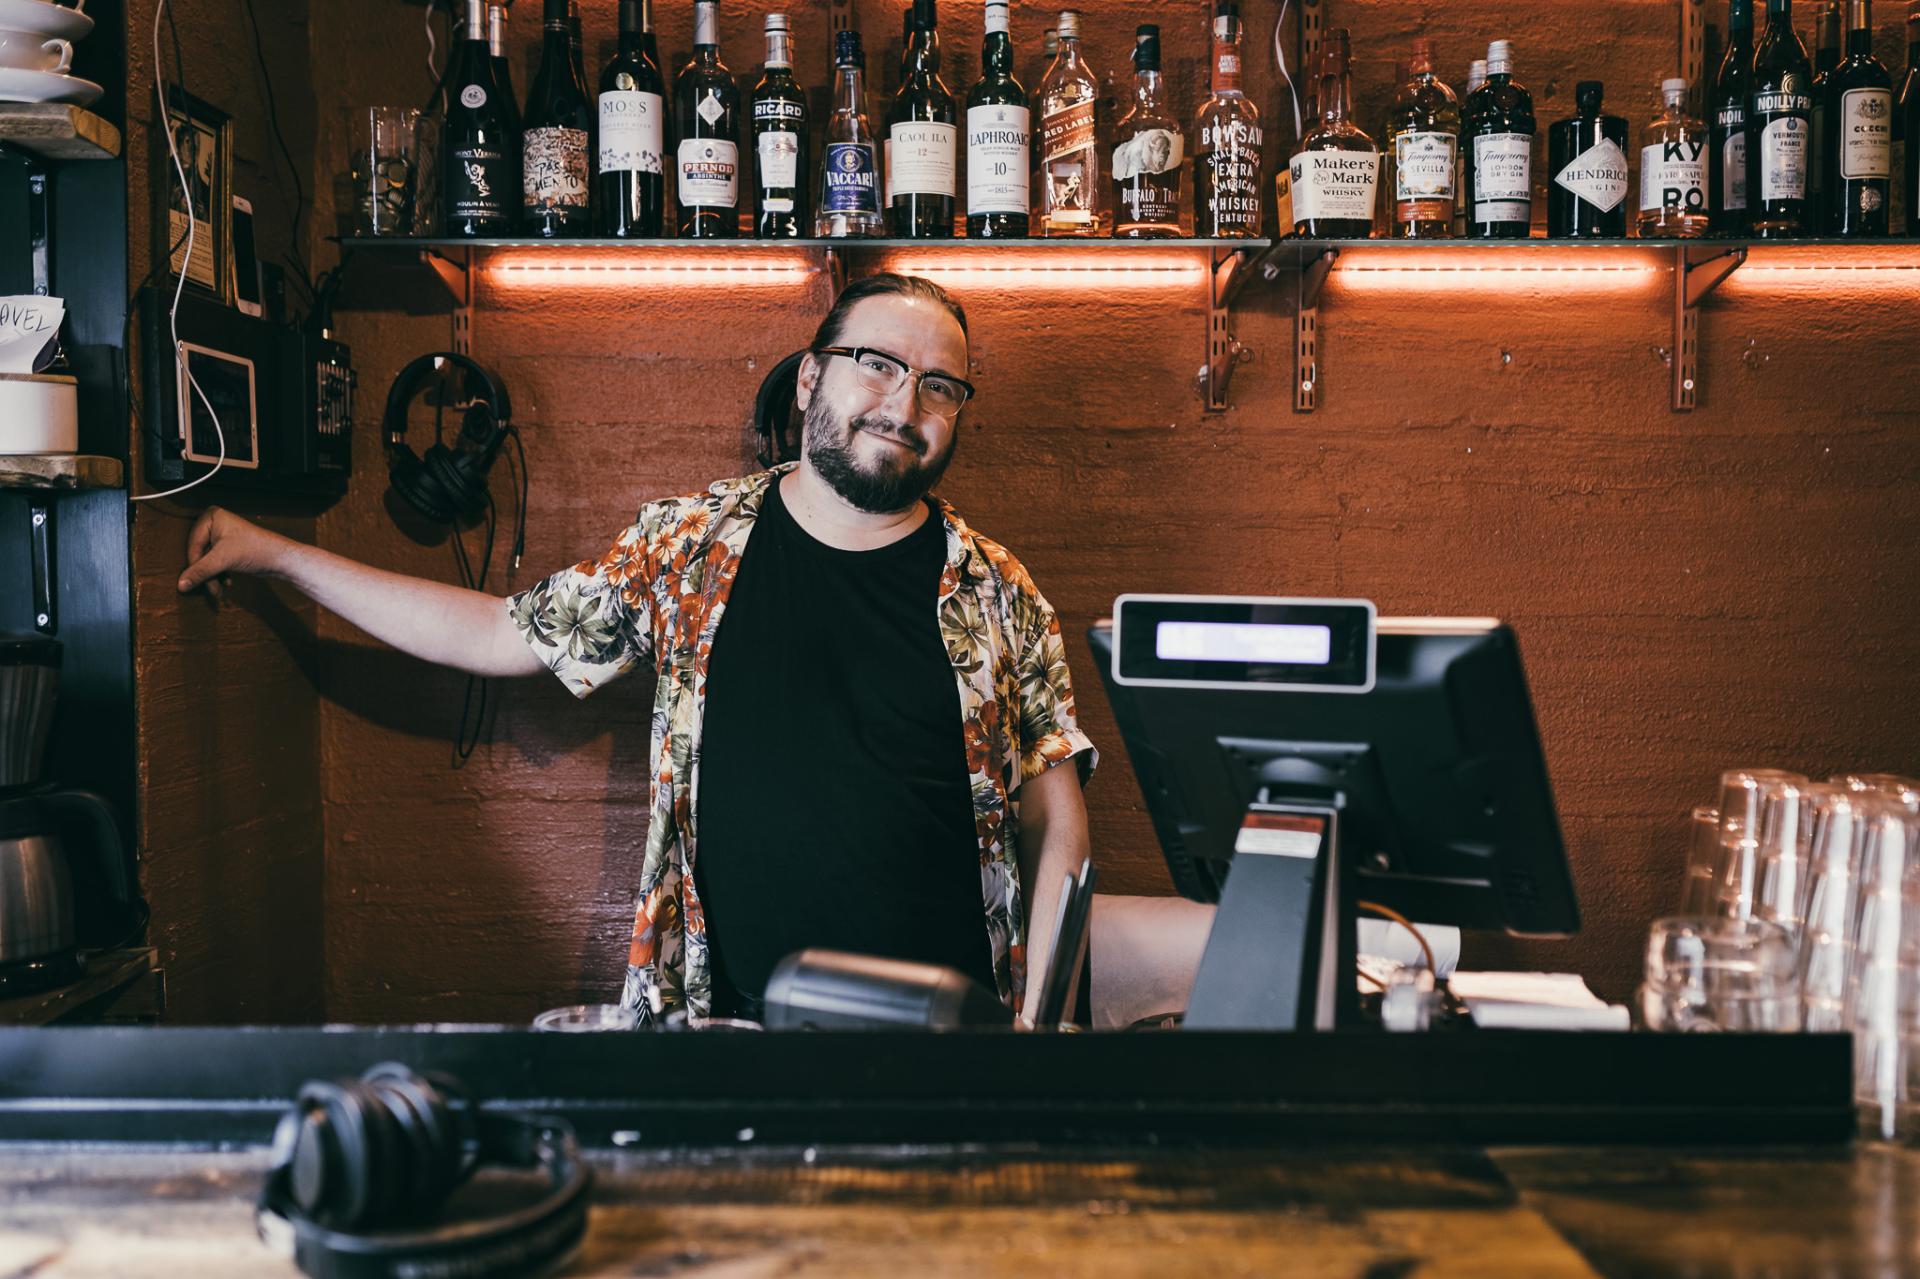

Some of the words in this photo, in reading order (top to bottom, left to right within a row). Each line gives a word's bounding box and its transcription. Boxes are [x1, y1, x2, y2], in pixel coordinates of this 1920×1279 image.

[754, 102, 802, 117] RICARD
[1757, 96, 1795, 110] NOILLY
[1044, 127, 1063, 139] RED
[1065, 115, 1095, 131] LABEL
[898, 132, 928, 144] CAOL
[932, 133, 948, 144] ILA
[1202, 125, 1263, 146] BOWSAW
[1207, 147, 1232, 167] SMAL
[1240, 147, 1260, 168] BATCH
[1664, 141, 1701, 162] KY
[684, 163, 733, 174] PERNOD
[994, 162, 1007, 175] 10
[1218, 163, 1254, 177] EXTRA
[1313, 158, 1375, 170] Maker's
[1410, 165, 1445, 174] SEVILLA
[826, 171, 873, 187] VACCARI
[1332, 172, 1374, 184] Mark
[1122, 188, 1155, 204] BUFALO
[1208, 197, 1259, 211] WHISKEY
[1215, 213, 1256, 223] ENTUCKY
